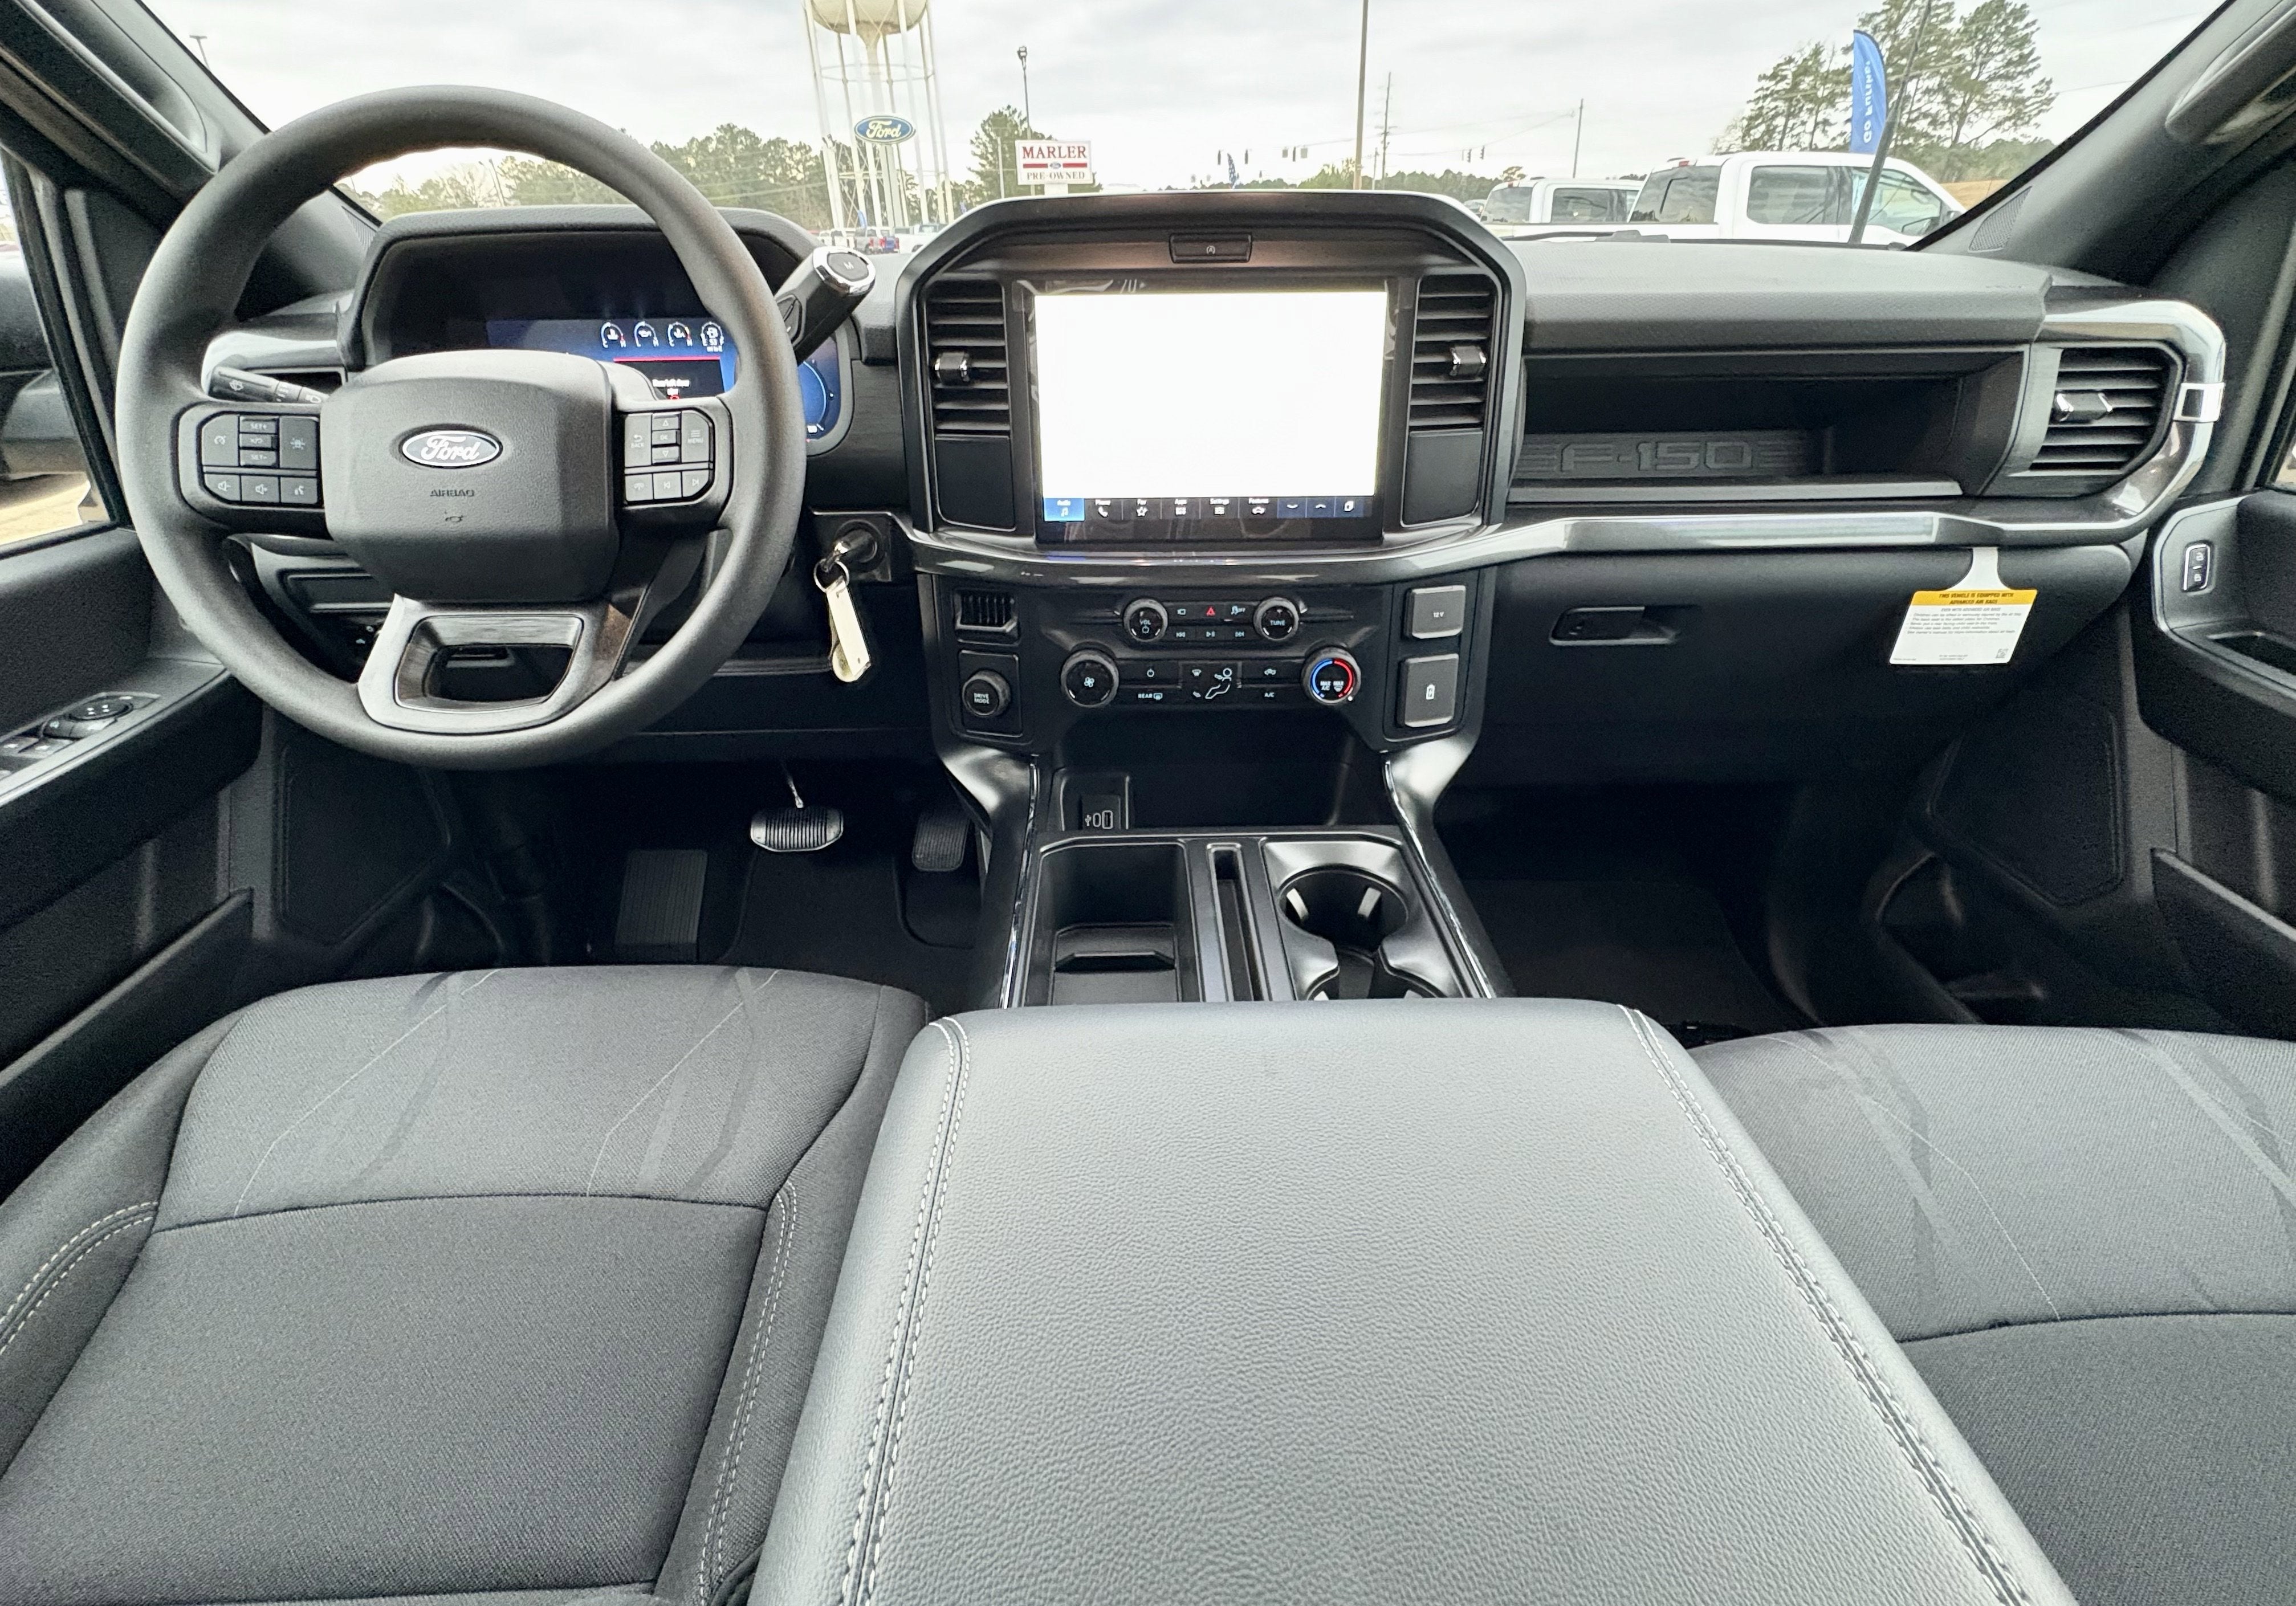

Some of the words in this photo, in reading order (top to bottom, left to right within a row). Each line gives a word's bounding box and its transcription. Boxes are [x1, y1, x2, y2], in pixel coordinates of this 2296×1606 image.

[866, 120, 902, 138] Ford
[1021, 145, 1088, 159] MARLER
[1027, 172, 1086, 181] PRE-OWNED
[420, 435, 481, 460] Ford
[1560, 441, 1753, 472] F-150
